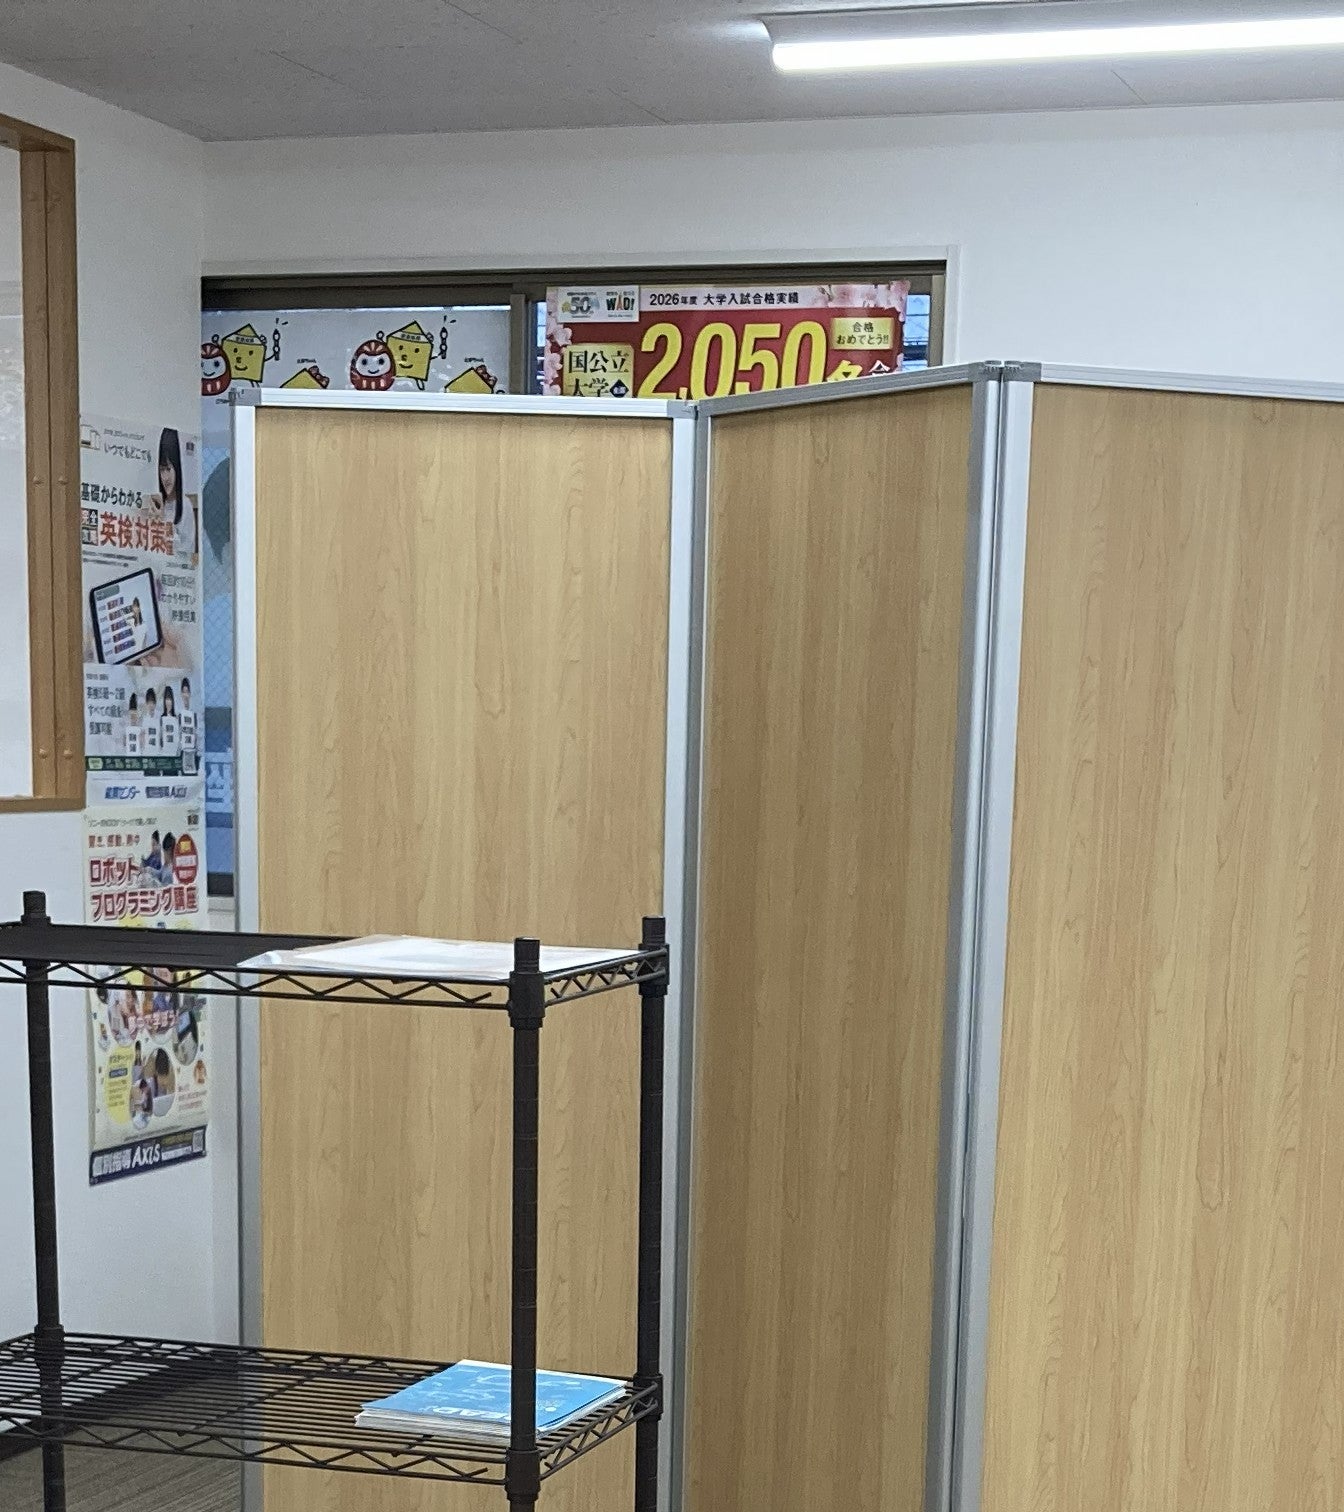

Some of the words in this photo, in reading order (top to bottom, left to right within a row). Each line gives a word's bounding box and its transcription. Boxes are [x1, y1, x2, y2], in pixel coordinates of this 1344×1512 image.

[650, 293, 698, 306] 2026年度
[702, 292, 799, 305] 大学入試合格実績
[852, 322, 874, 333] 合格
[568, 350, 630, 373] 国公立
[81, 481, 143, 509] 基礎からわかる
[90, 856, 140, 885] ロボット
